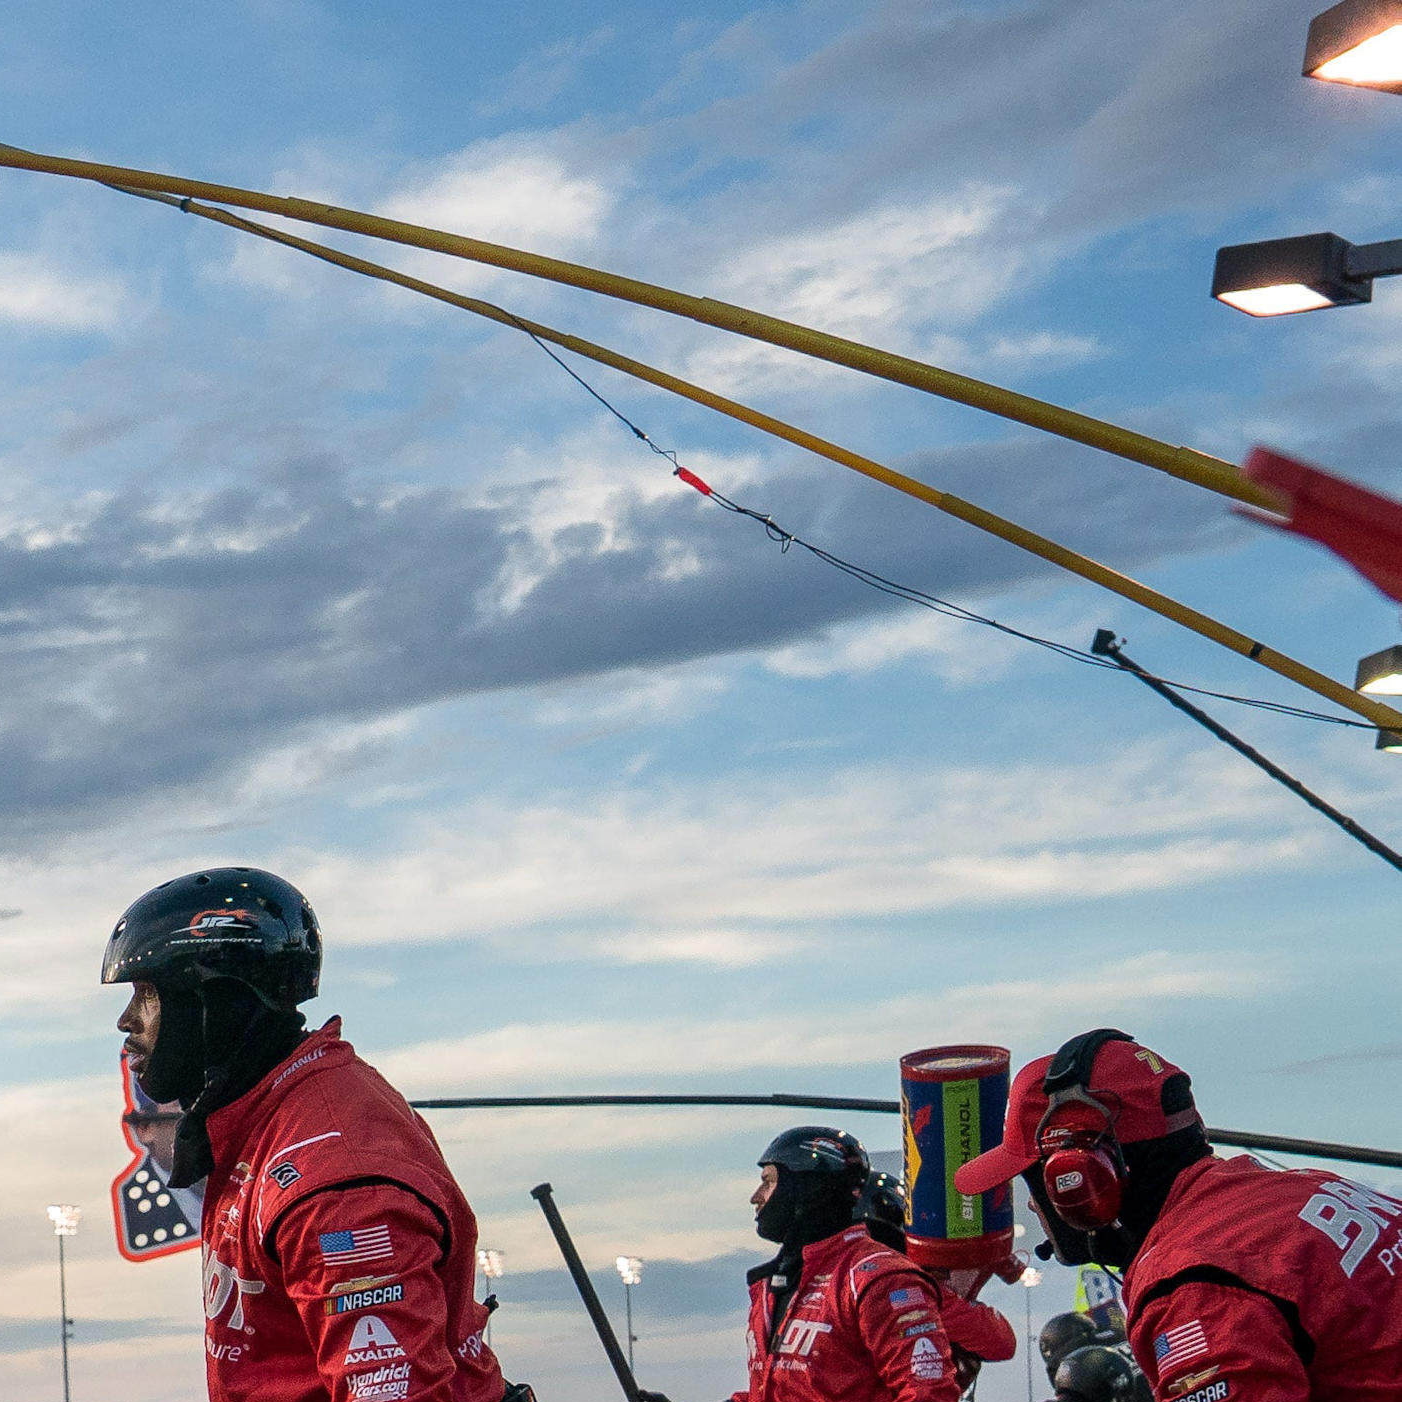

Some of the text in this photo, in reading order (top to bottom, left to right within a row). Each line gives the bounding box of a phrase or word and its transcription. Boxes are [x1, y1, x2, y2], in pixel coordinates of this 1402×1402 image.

[1135, 1050, 1164, 1075] 7
[343, 1285, 403, 1312] NASCAR
[344, 1346, 407, 1365] AXALTA
[346, 1362, 412, 1395] Hendrick
